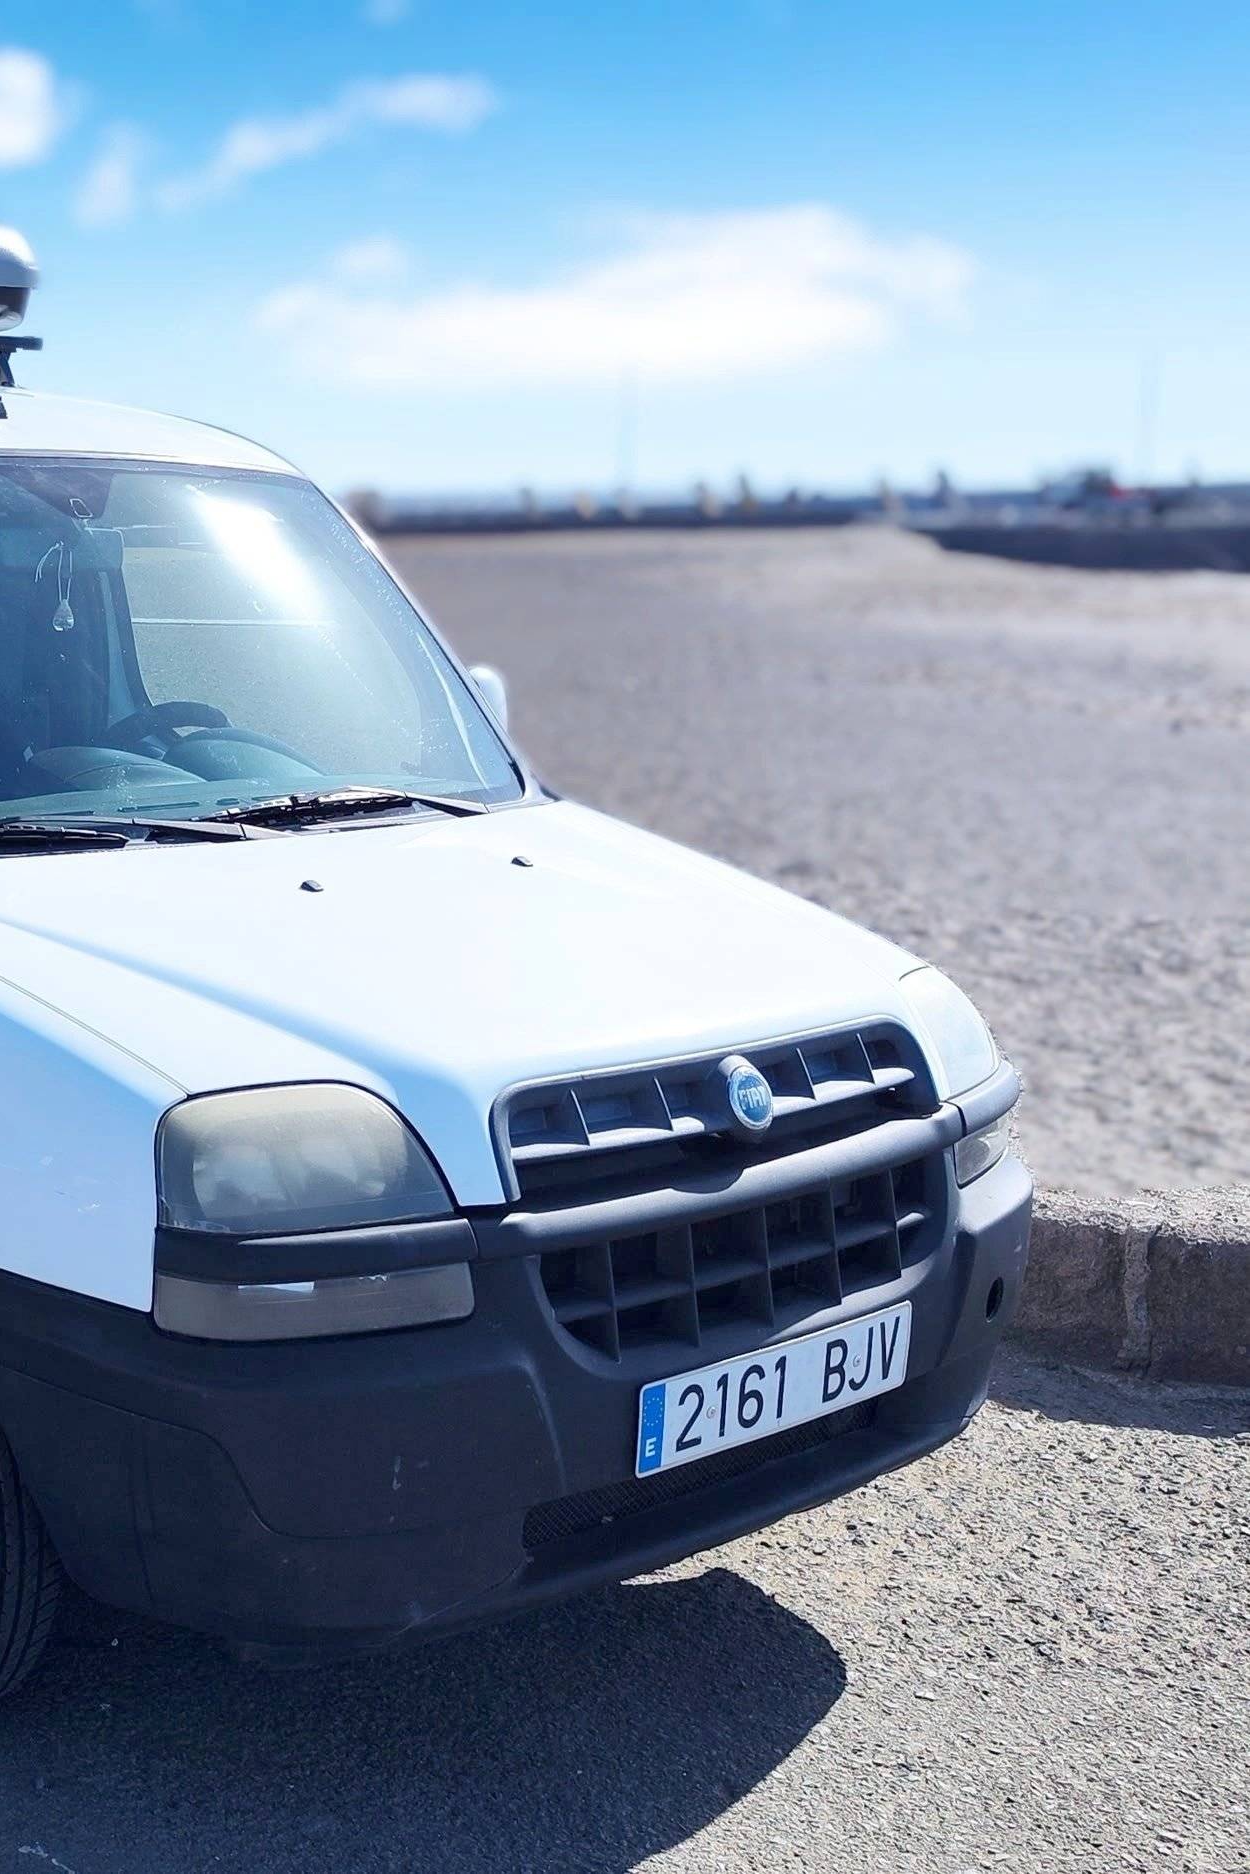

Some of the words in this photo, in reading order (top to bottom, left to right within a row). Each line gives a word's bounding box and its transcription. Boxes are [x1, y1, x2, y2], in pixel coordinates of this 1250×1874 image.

[738, 1085, 768, 1110] FIAT
[675, 1355, 787, 1452] 2161
[821, 1316, 901, 1404] BJV
[645, 1437, 656, 1457] E
